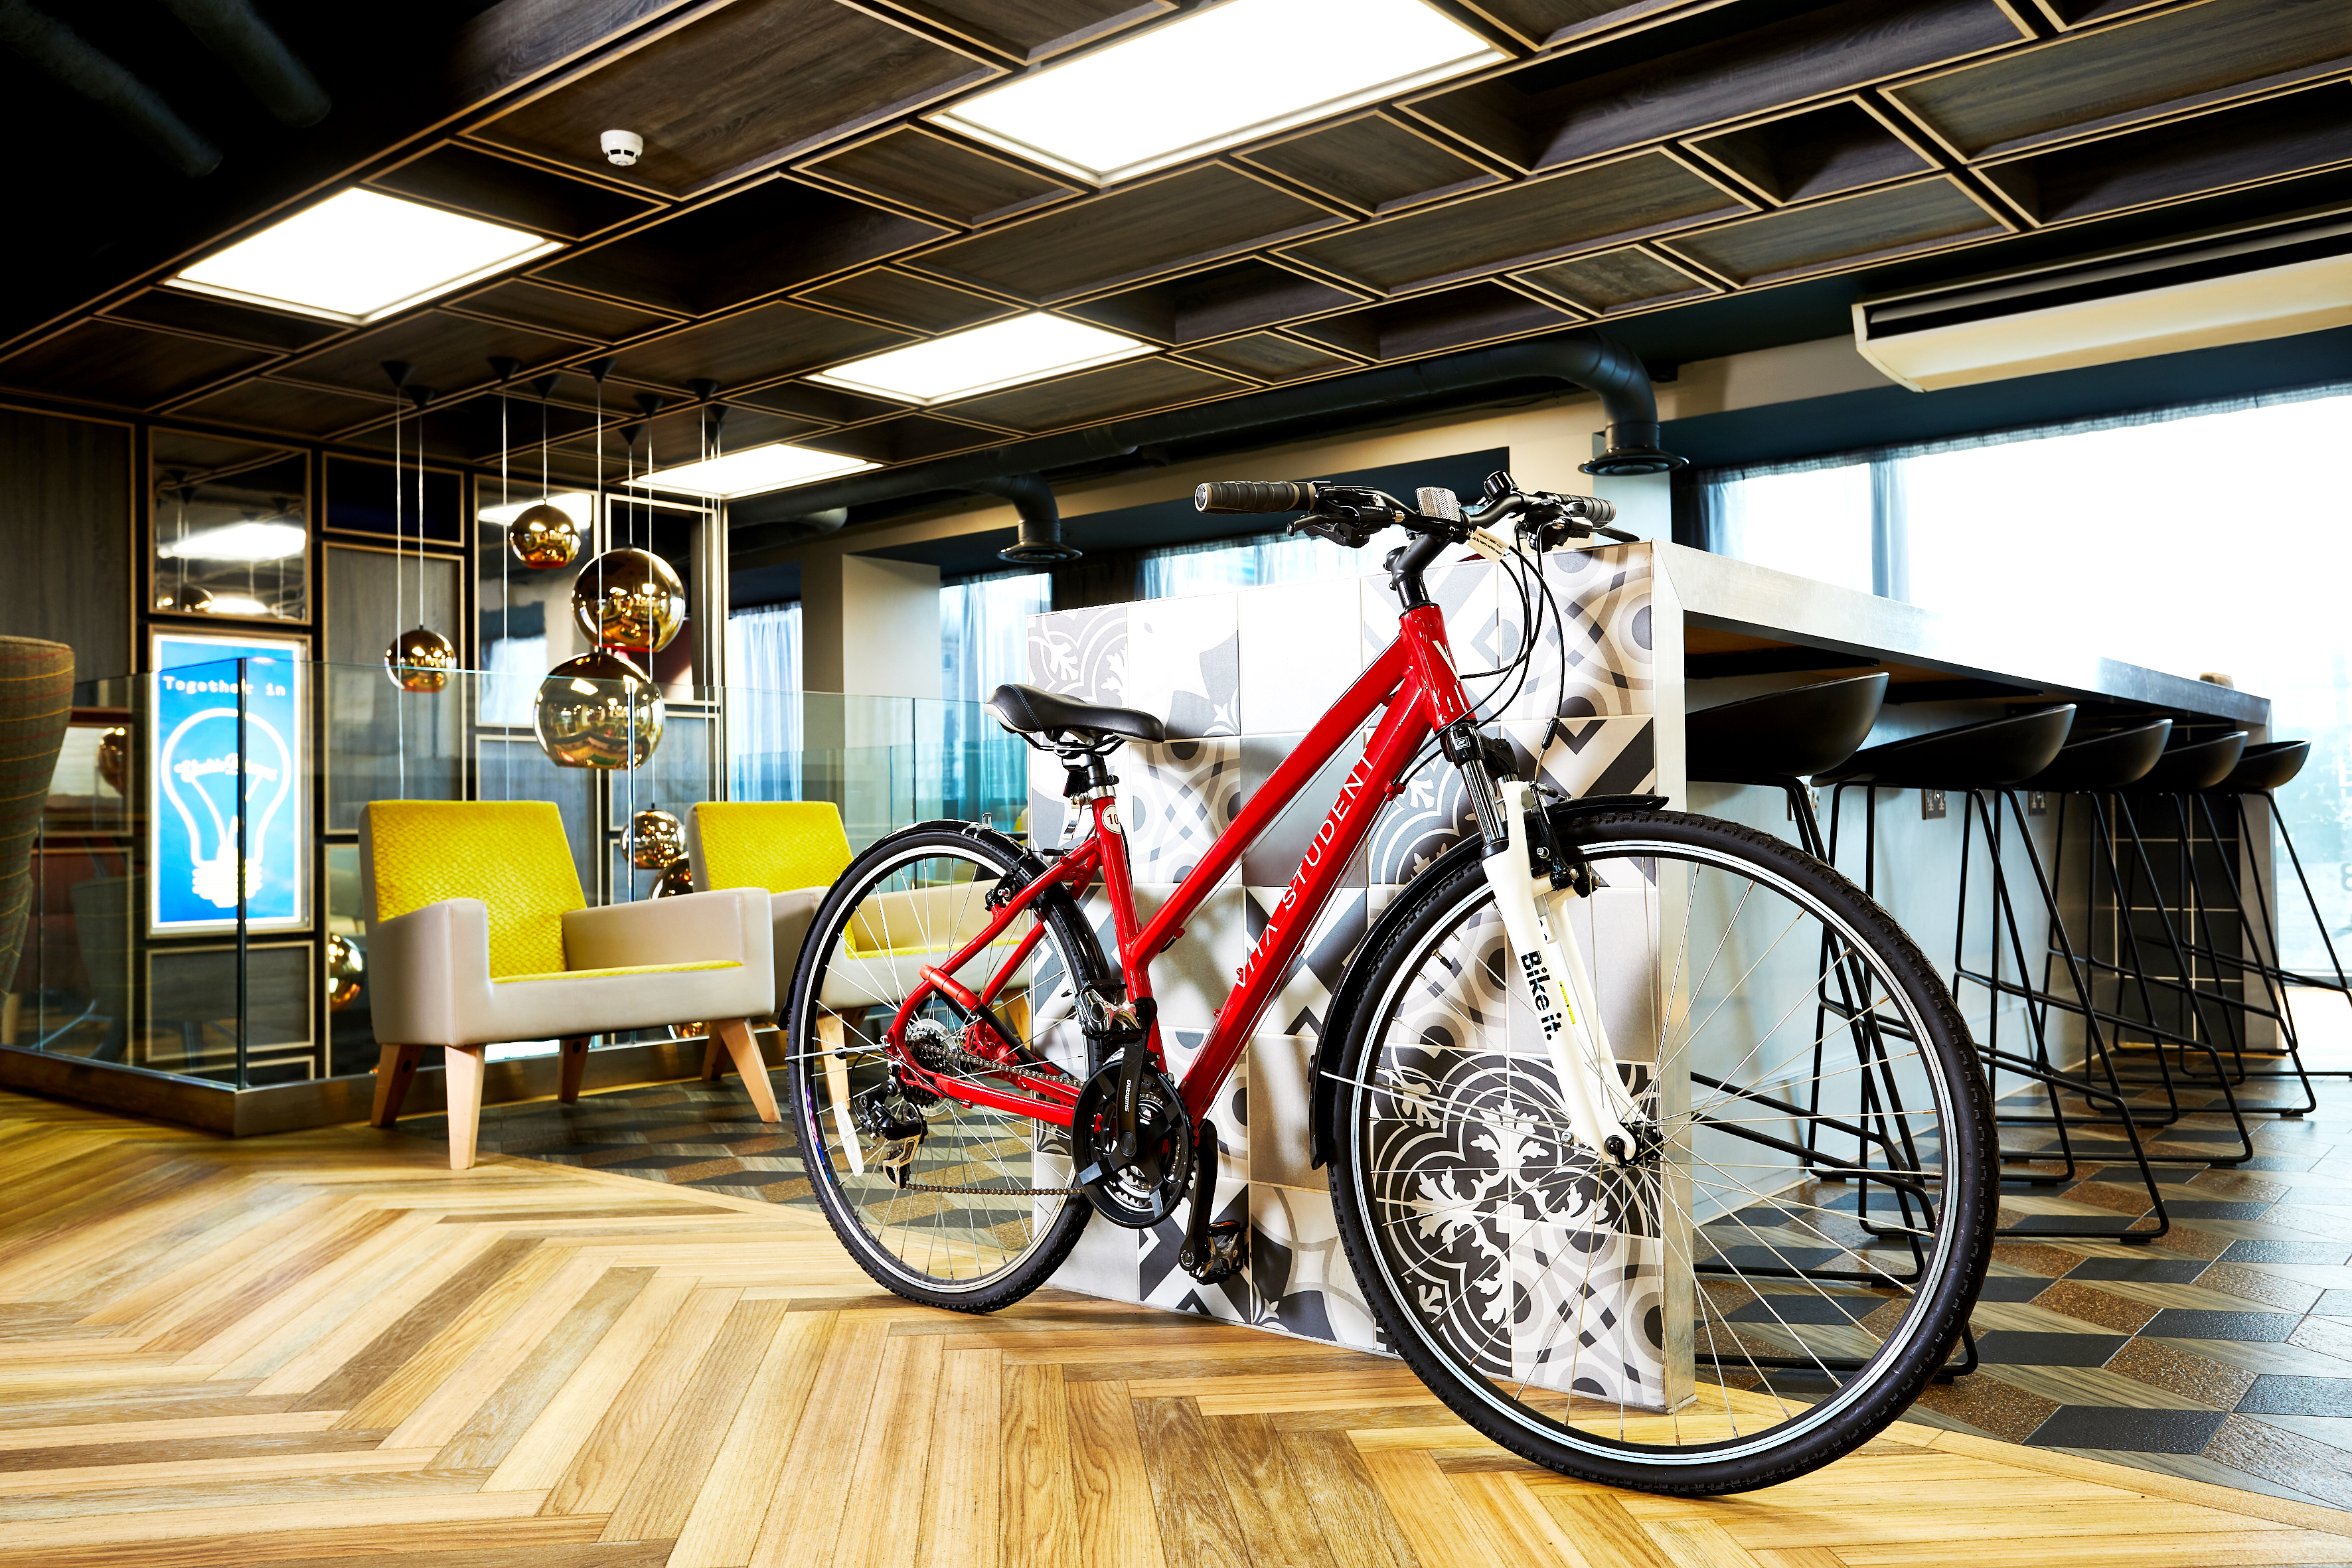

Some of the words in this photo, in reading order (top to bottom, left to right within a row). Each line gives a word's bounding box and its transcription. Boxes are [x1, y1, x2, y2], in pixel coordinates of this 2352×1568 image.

[162, 675, 254, 694] Together
[265, 682, 286, 696] in
[1107, 813, 1119, 824] 10
[1235, 923, 1279, 988] VITA
[1282, 747, 1374, 911] STUDENT
[1520, 950, 1551, 1012] Bike
